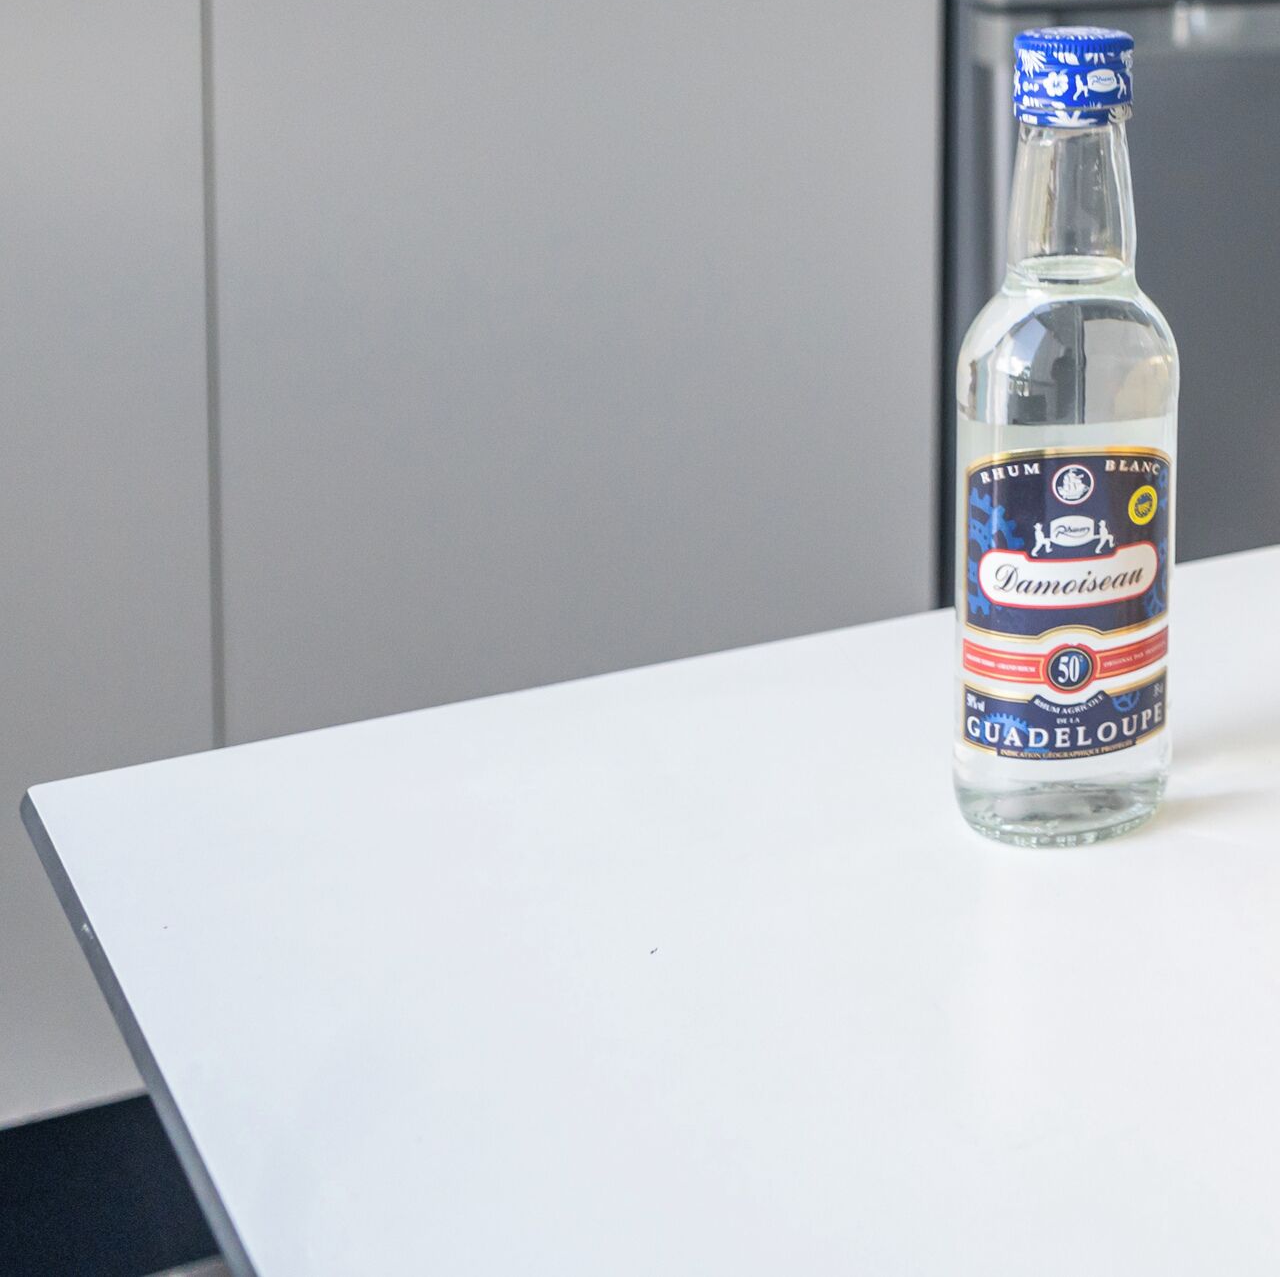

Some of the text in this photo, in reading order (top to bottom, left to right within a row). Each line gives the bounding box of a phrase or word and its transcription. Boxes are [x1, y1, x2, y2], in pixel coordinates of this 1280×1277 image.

[980, 462, 1040, 484] RHUM
[1105, 459, 1161, 475] BLANC
[993, 563, 1143, 595] Damoiseau
[1034, 698, 1060, 714] RHUM
[967, 702, 1162, 748] GUADELOUPE
[1056, 717, 1067, 725] DE
